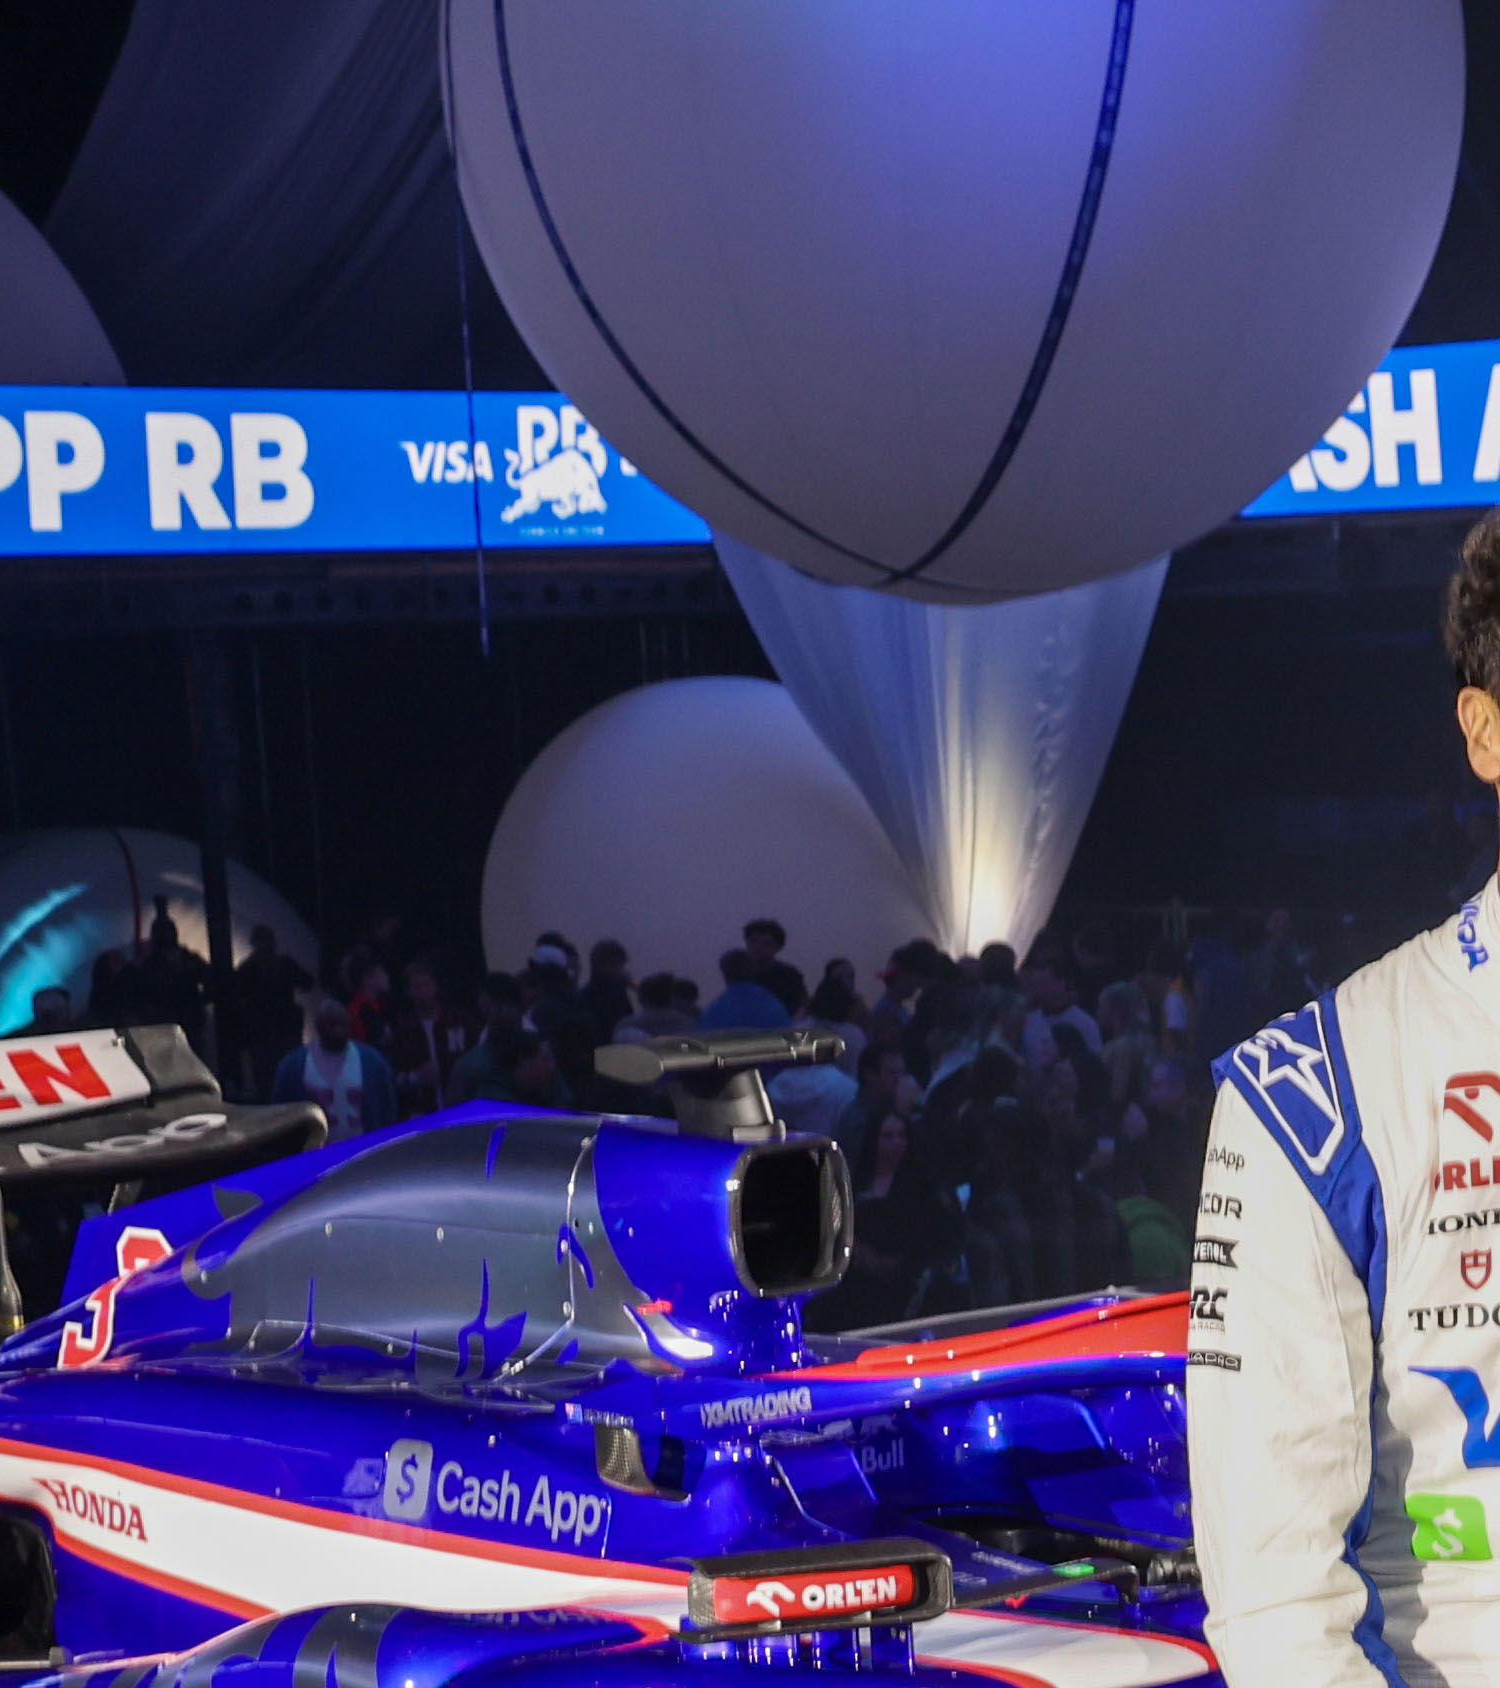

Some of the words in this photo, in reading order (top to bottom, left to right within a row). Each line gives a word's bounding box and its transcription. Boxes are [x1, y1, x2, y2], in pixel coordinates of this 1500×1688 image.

[401, 441, 494, 483] VISA
[1289, 368, 1443, 492] SH
[145, 411, 315, 531] RB
[861, 1438, 905, 1474] Bull
[33, 1478, 148, 1543] HONDA
[437, 1461, 523, 1524] Cash
[525, 1475, 603, 1547] App
[801, 1575, 896, 1610] ORLEN
